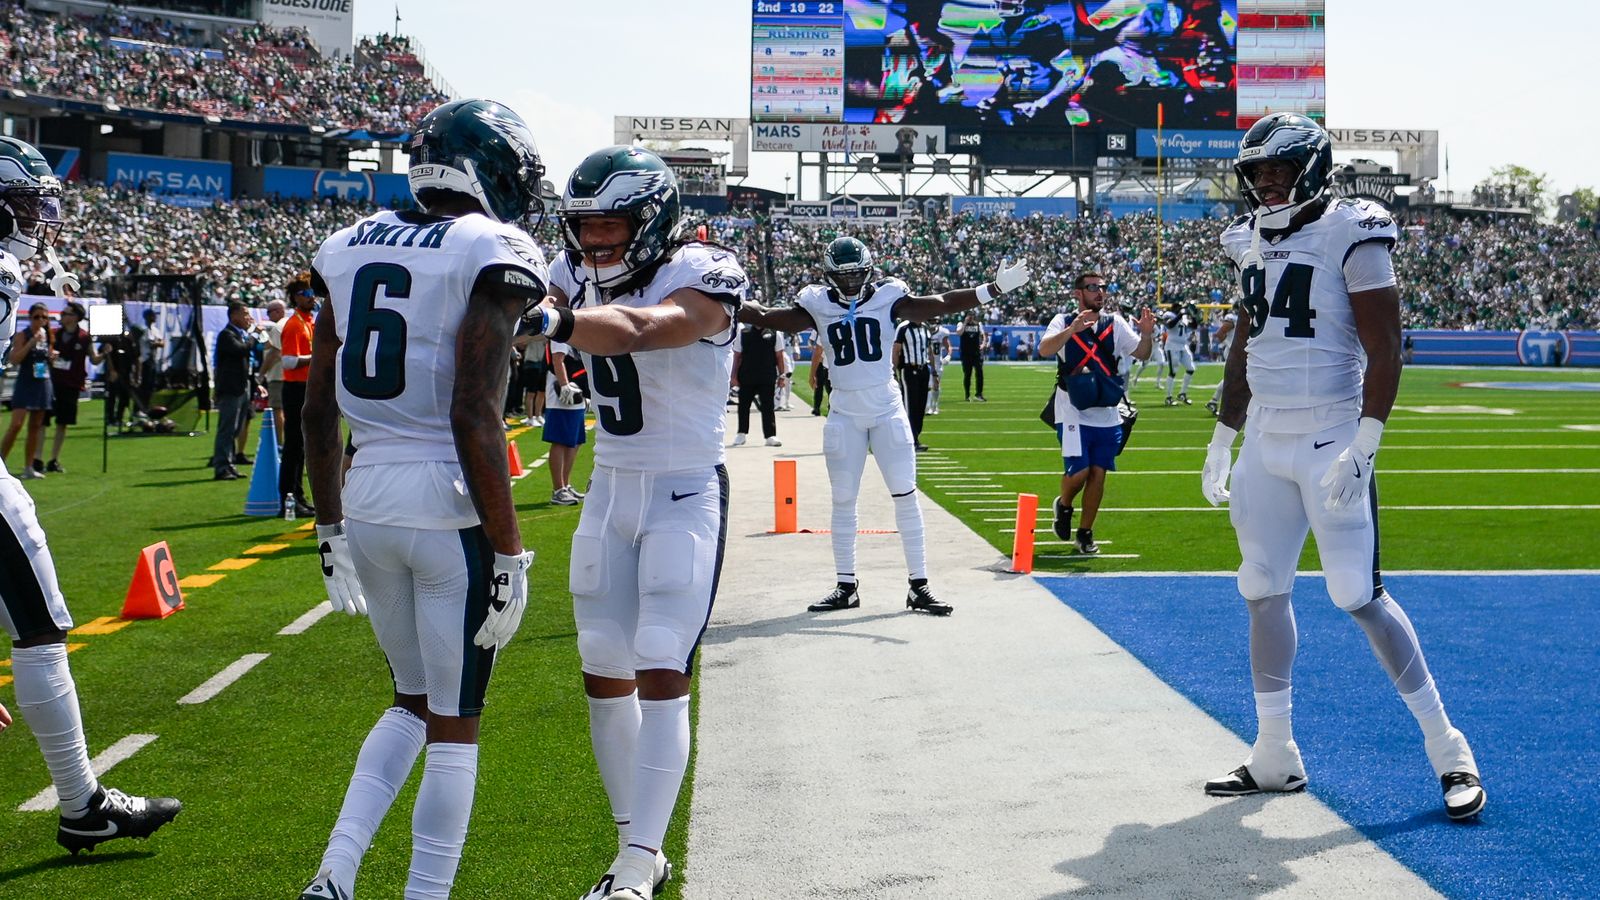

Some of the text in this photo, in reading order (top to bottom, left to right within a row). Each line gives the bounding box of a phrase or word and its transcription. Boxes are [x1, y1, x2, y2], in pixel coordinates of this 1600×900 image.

[818, 3, 834, 13] 22
[768, 31, 829, 39] RUSHING
[822, 48, 836, 57] 22
[632, 118, 731, 131] NISSAN
[757, 125, 801, 137] MARS
[823, 126, 830, 136] A
[1327, 130, 1421, 143] NISSAN
[757, 141, 793, 150] Petcare
[1109, 136, 1124, 148] 34
[1168, 133, 1202, 154] Kroger
[1208, 140, 1235, 149] FRESH
[116, 168, 223, 191] NISSAN
[793, 206, 825, 215] ROCKY
[865, 207, 887, 215] LAW
[975, 202, 1016, 210] TITANS
[347, 219, 457, 249] SMITH
[1241, 262, 1317, 338] 84
[341, 262, 412, 400] 6
[828, 317, 883, 367] 80
[591, 353, 642, 436] 9
[154, 547, 182, 609] G
